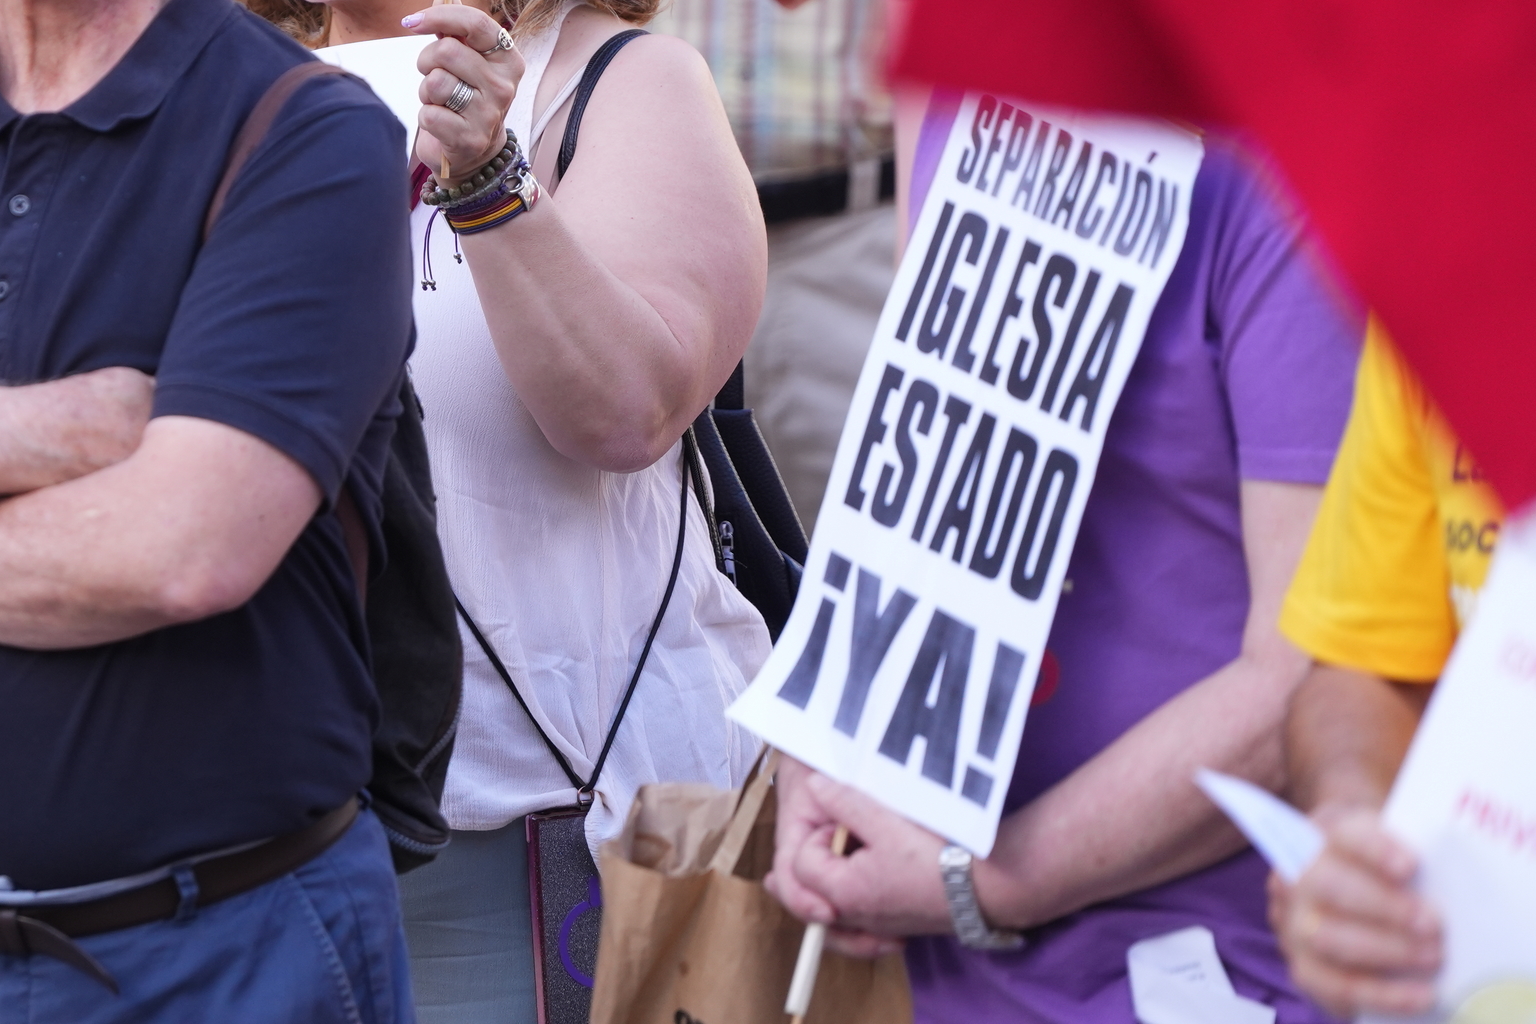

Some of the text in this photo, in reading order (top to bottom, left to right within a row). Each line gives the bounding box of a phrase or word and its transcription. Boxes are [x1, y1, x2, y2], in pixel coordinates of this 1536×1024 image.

[955, 93, 1181, 270] SEPARACIÓN
[895, 199, 1136, 434] IGLESIA
[843, 362, 1080, 603] ESTADO
[776, 549, 1027, 809] ¡YA!
